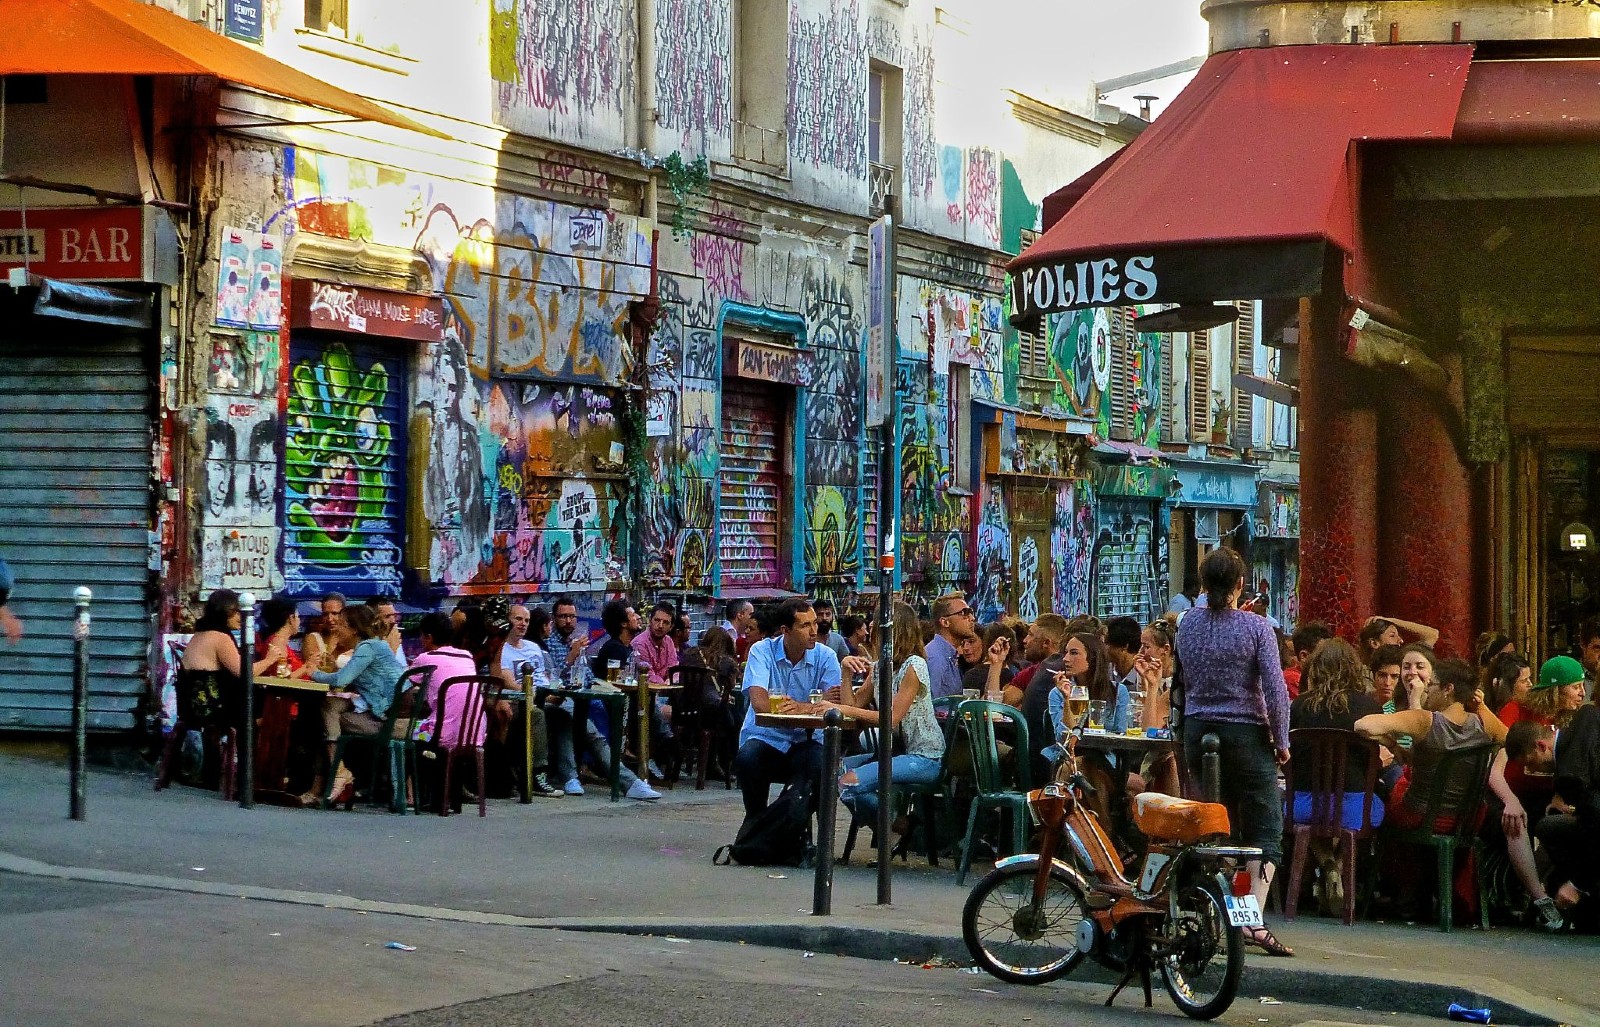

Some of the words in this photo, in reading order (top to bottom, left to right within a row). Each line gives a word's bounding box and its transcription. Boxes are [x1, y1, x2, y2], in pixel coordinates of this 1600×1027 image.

[59, 227, 131, 263] BAR
[1022, 255, 1158, 312] FOLIES
[1237, 896, 1250, 909] CL
[1231, 910, 1251, 923] 895
[1253, 910, 1260, 922] R
